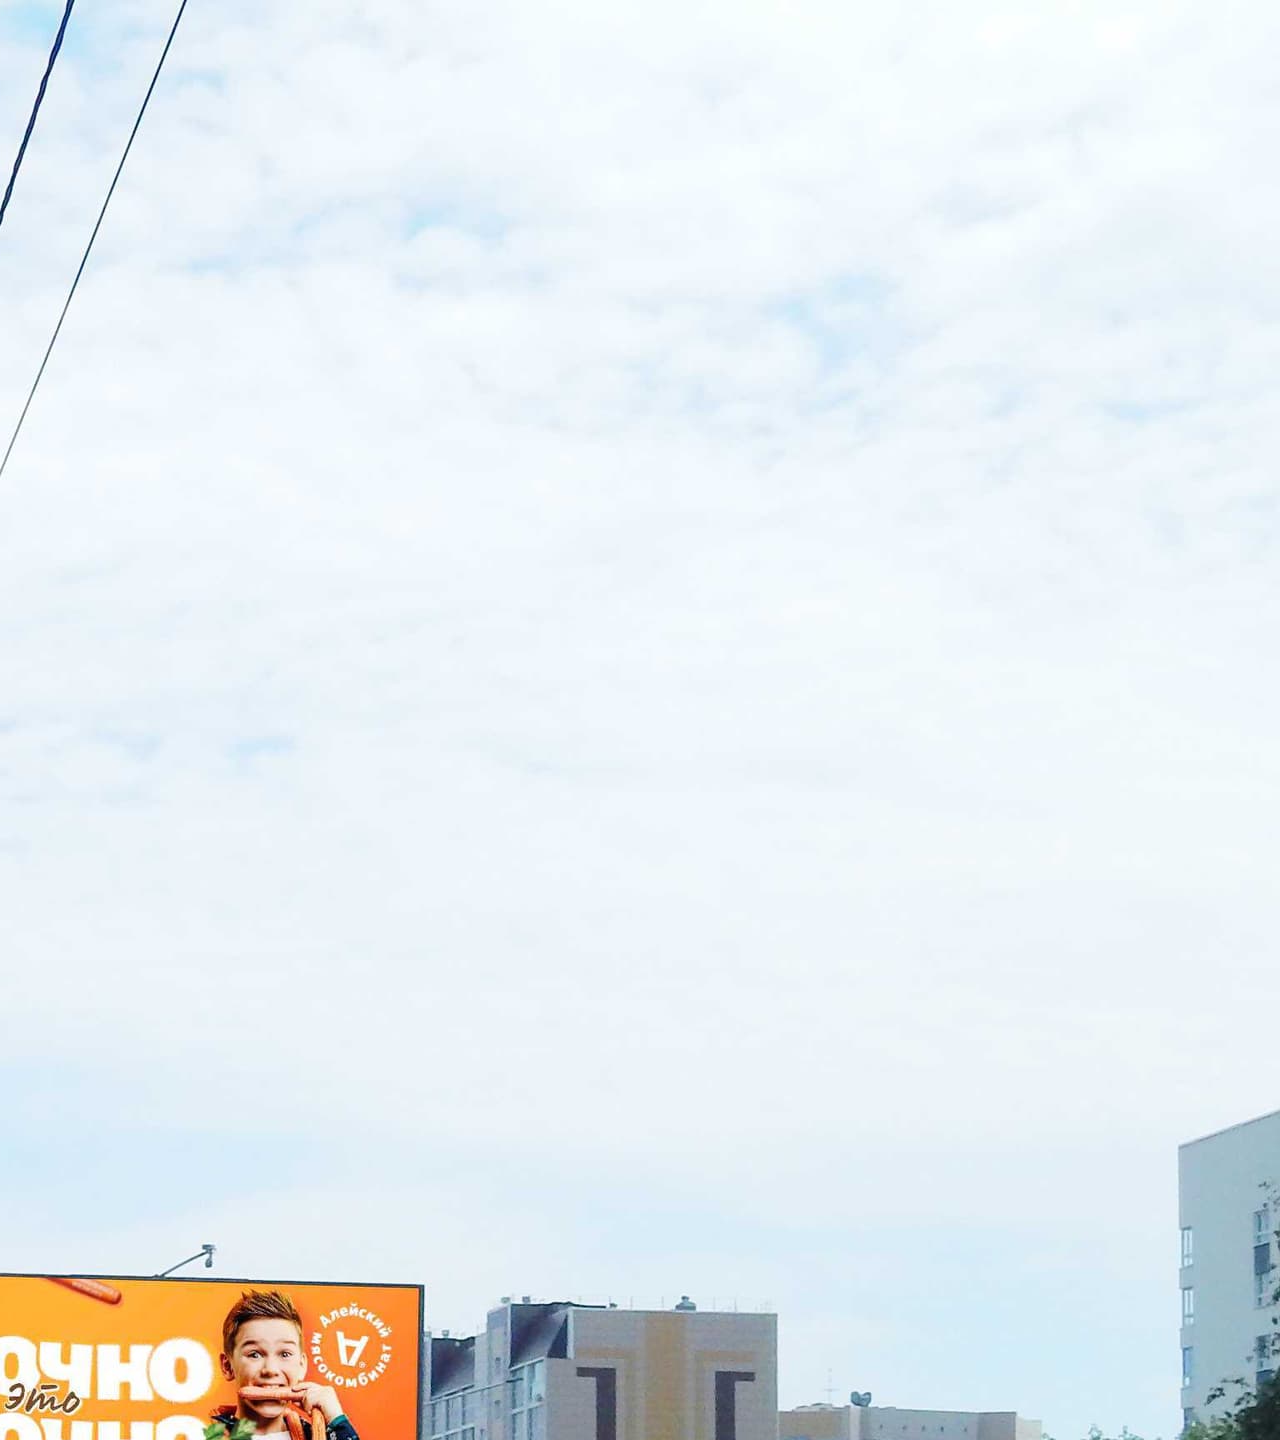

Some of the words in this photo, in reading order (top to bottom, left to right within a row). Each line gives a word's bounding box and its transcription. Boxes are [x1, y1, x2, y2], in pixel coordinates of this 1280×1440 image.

[320, 1302, 392, 1338] Алейский
[311, 1331, 392, 1388] мясокомбинат
[5, 1382, 81, 1413] это
